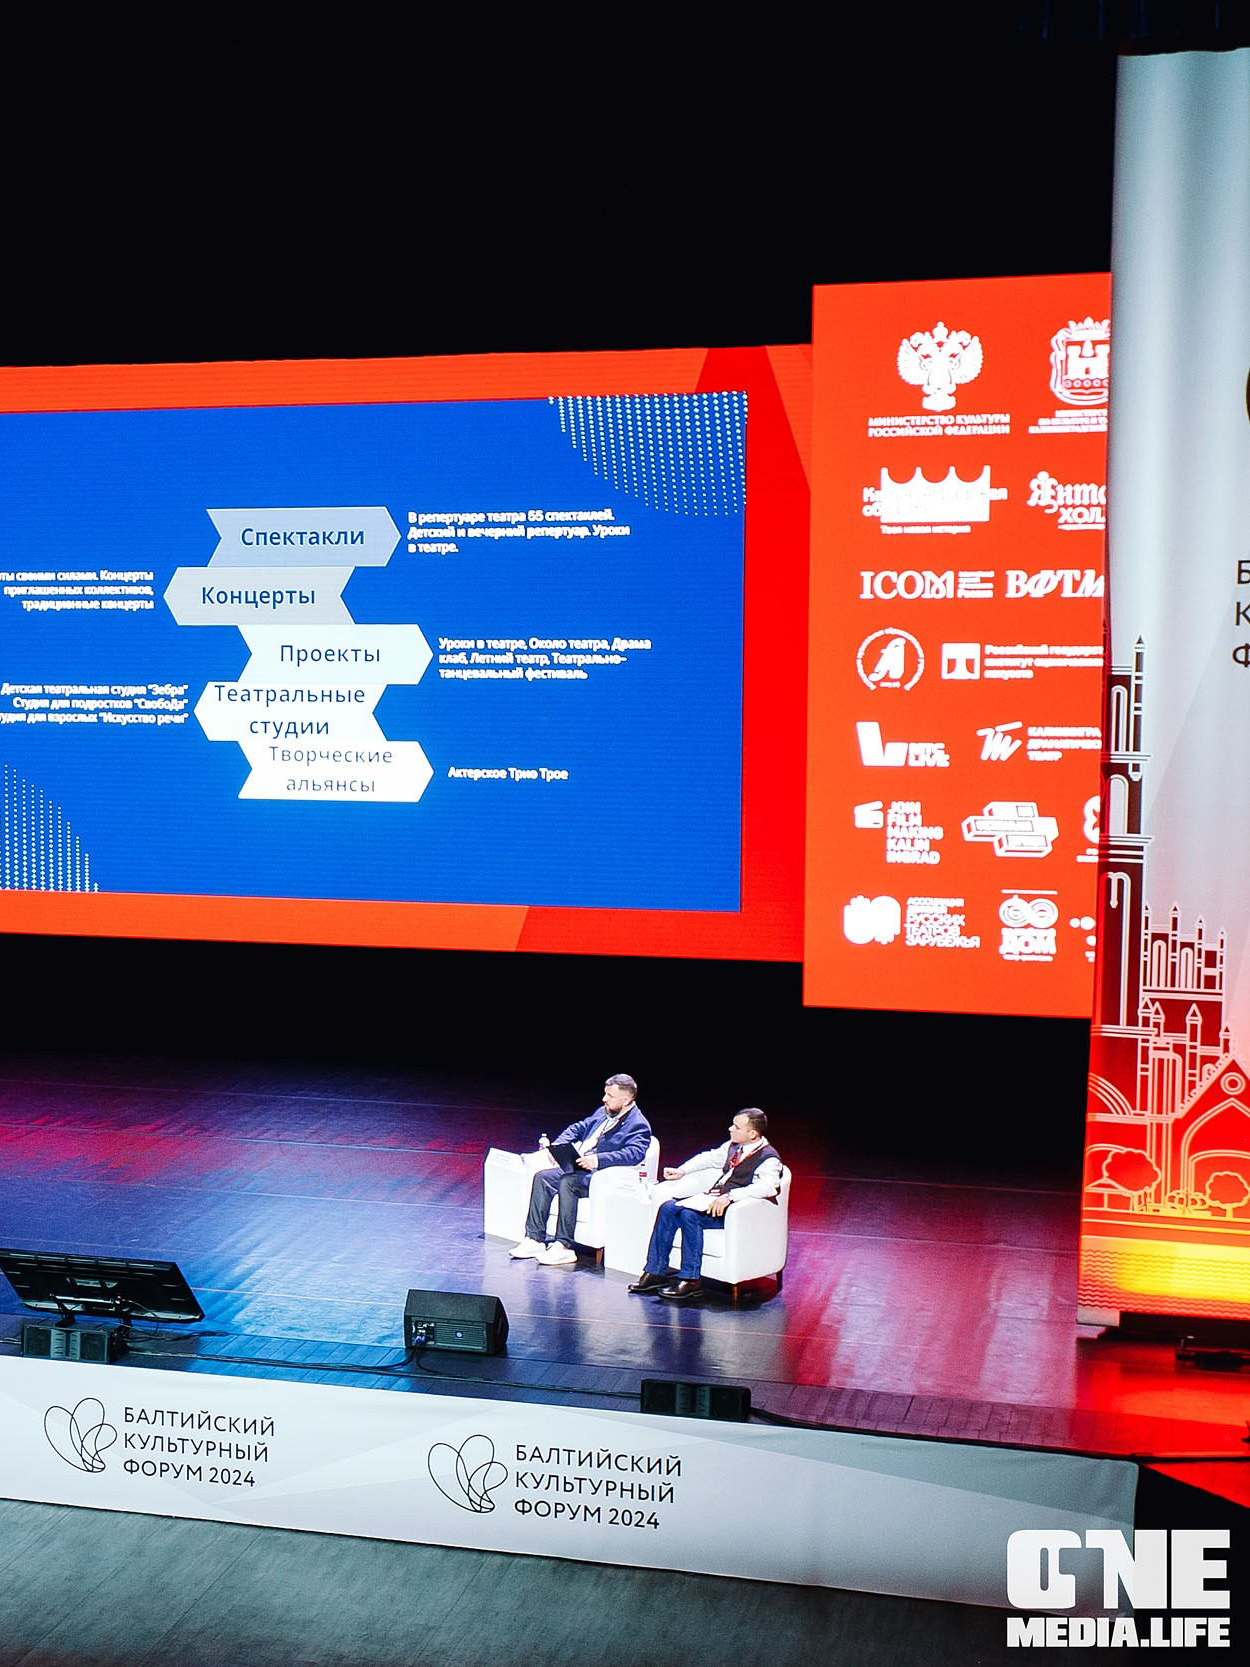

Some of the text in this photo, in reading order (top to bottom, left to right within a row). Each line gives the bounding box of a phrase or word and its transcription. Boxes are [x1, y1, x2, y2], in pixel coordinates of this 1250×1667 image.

[408, 508, 616, 524] В репертуаре театра 55 спектаклей.
[241, 527, 365, 546] Спектакли
[407, 526, 456, 539] Детский
[457, 528, 466, 538] и
[467, 525, 525, 539] вечерний
[592, 524, 631, 539] Уроки
[408, 543, 417, 553] в
[16, 572, 56, 582] своими
[100, 569, 154, 583] Концерты
[3, 585, 83, 597] приглашенных
[860, 571, 954, 599] ICOM
[22, 599, 154, 611] традиционные концерты
[201, 586, 316, 610] Концерты
[438, 637, 475, 649] Уроки
[477, 640, 485, 649] в
[528, 637, 567, 648] Около
[611, 637, 652, 650] Драма
[280, 645, 381, 667] Проекты
[470, 652, 514, 665] Летний
[552, 653, 627, 666] Театрально-
[438, 667, 588, 680] танцевальный фестиваль
[1, 683, 42, 695] Детская
[43, 685, 109, 696] театральная
[111, 686, 147, 697] студия
[214, 685, 365, 709] Театральные
[12, 697, 49, 709] Студия
[51, 700, 70, 710] для
[71, 699, 133, 710] подростков
[27, 713, 47, 724] для
[48, 713, 98, 724] взрослых
[249, 720, 329, 739] студии
[269, 746, 393, 767] Творческие
[448, 766, 569, 781] Актерское Трио Трое
[286, 777, 375, 792] альянсы
[905, 925, 960, 936] ТЕАТРОВ
[124, 1407, 275, 1437] БАЛТИЙСКИЙ
[124, 1434, 269, 1463] КУЛЬТУРНЫЙ
[516, 1444, 681, 1476] БАЛТИЙСКИЙ
[123, 1460, 255, 1487] ФОРУМ 2024
[515, 1471, 674, 1503] КУЛЬТУРНЫЙ
[514, 1498, 660, 1529] ФОРУМ 2024
